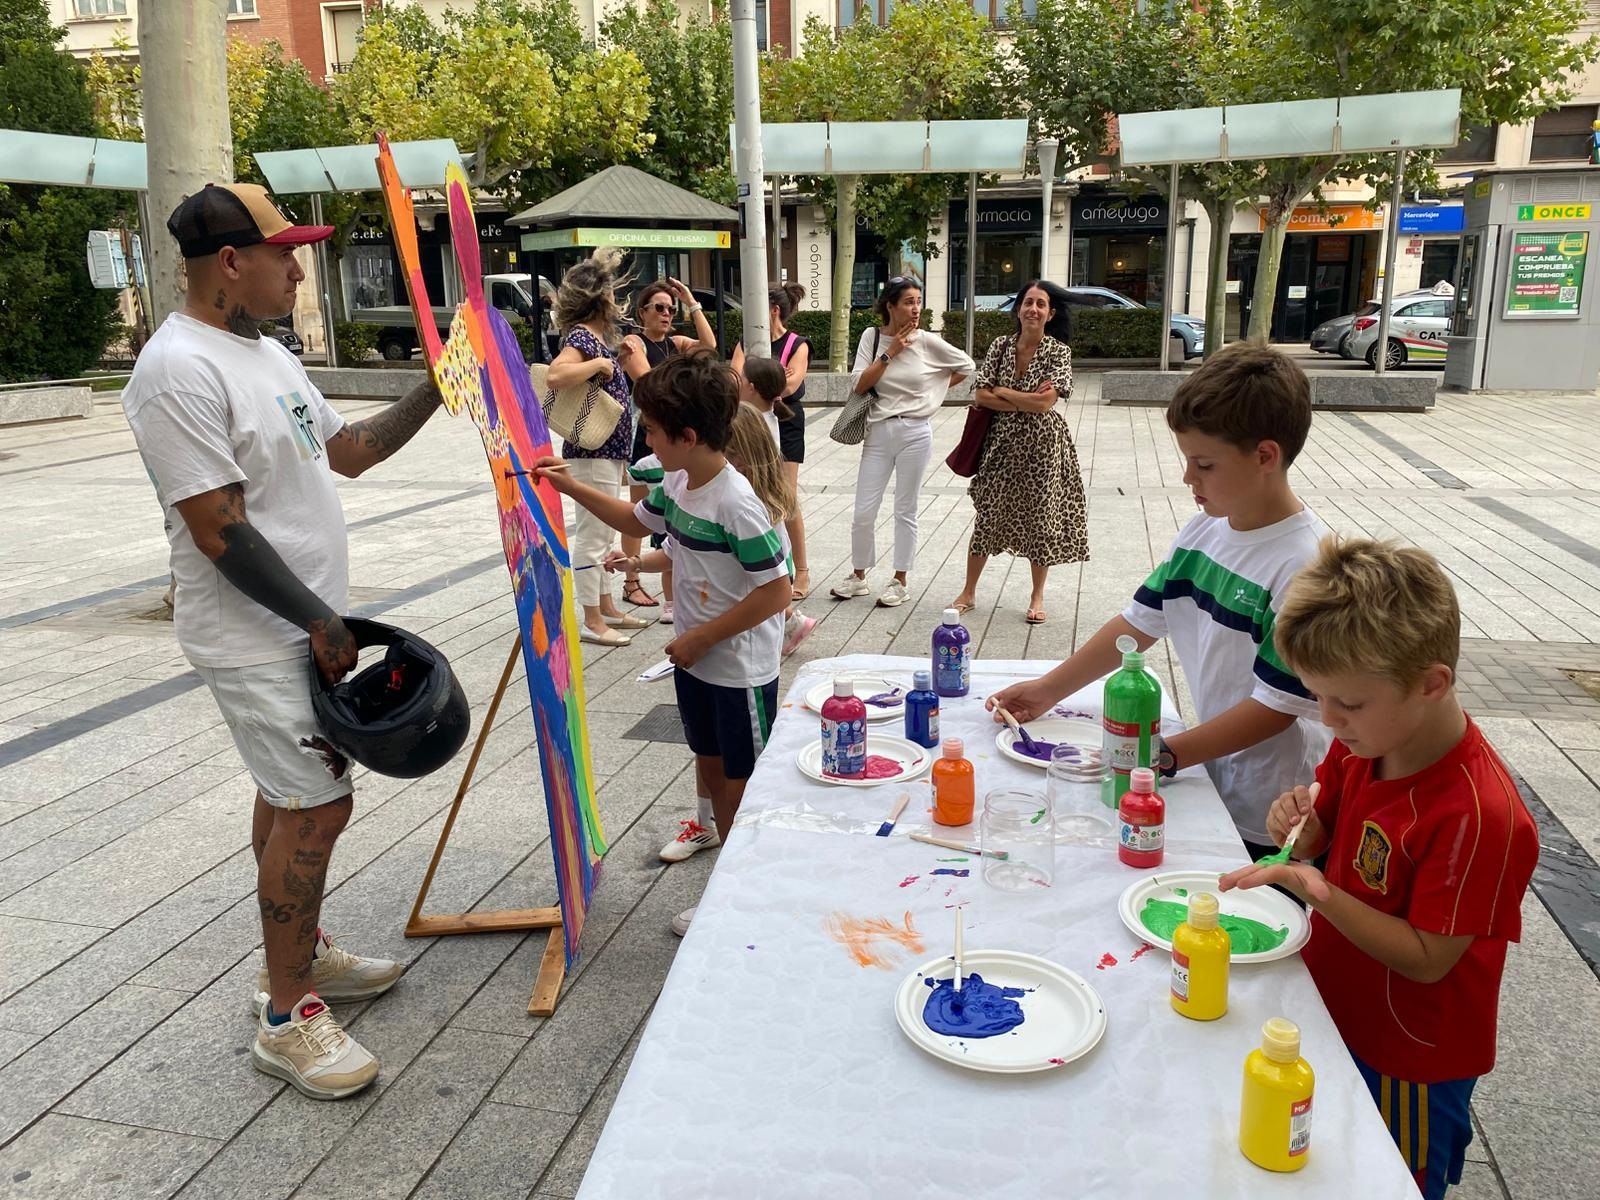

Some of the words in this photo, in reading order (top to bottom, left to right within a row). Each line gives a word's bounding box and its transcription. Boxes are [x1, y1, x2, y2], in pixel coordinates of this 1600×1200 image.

[1540, 207, 1585, 218] ONCE
[609, 233, 647, 242] OFICINA
[650, 234, 663, 242] DE
[667, 235, 707, 243] TURISMO
[1518, 263, 1575, 271] COMPRUEBA
[809, 243, 822, 309] ameyugo
